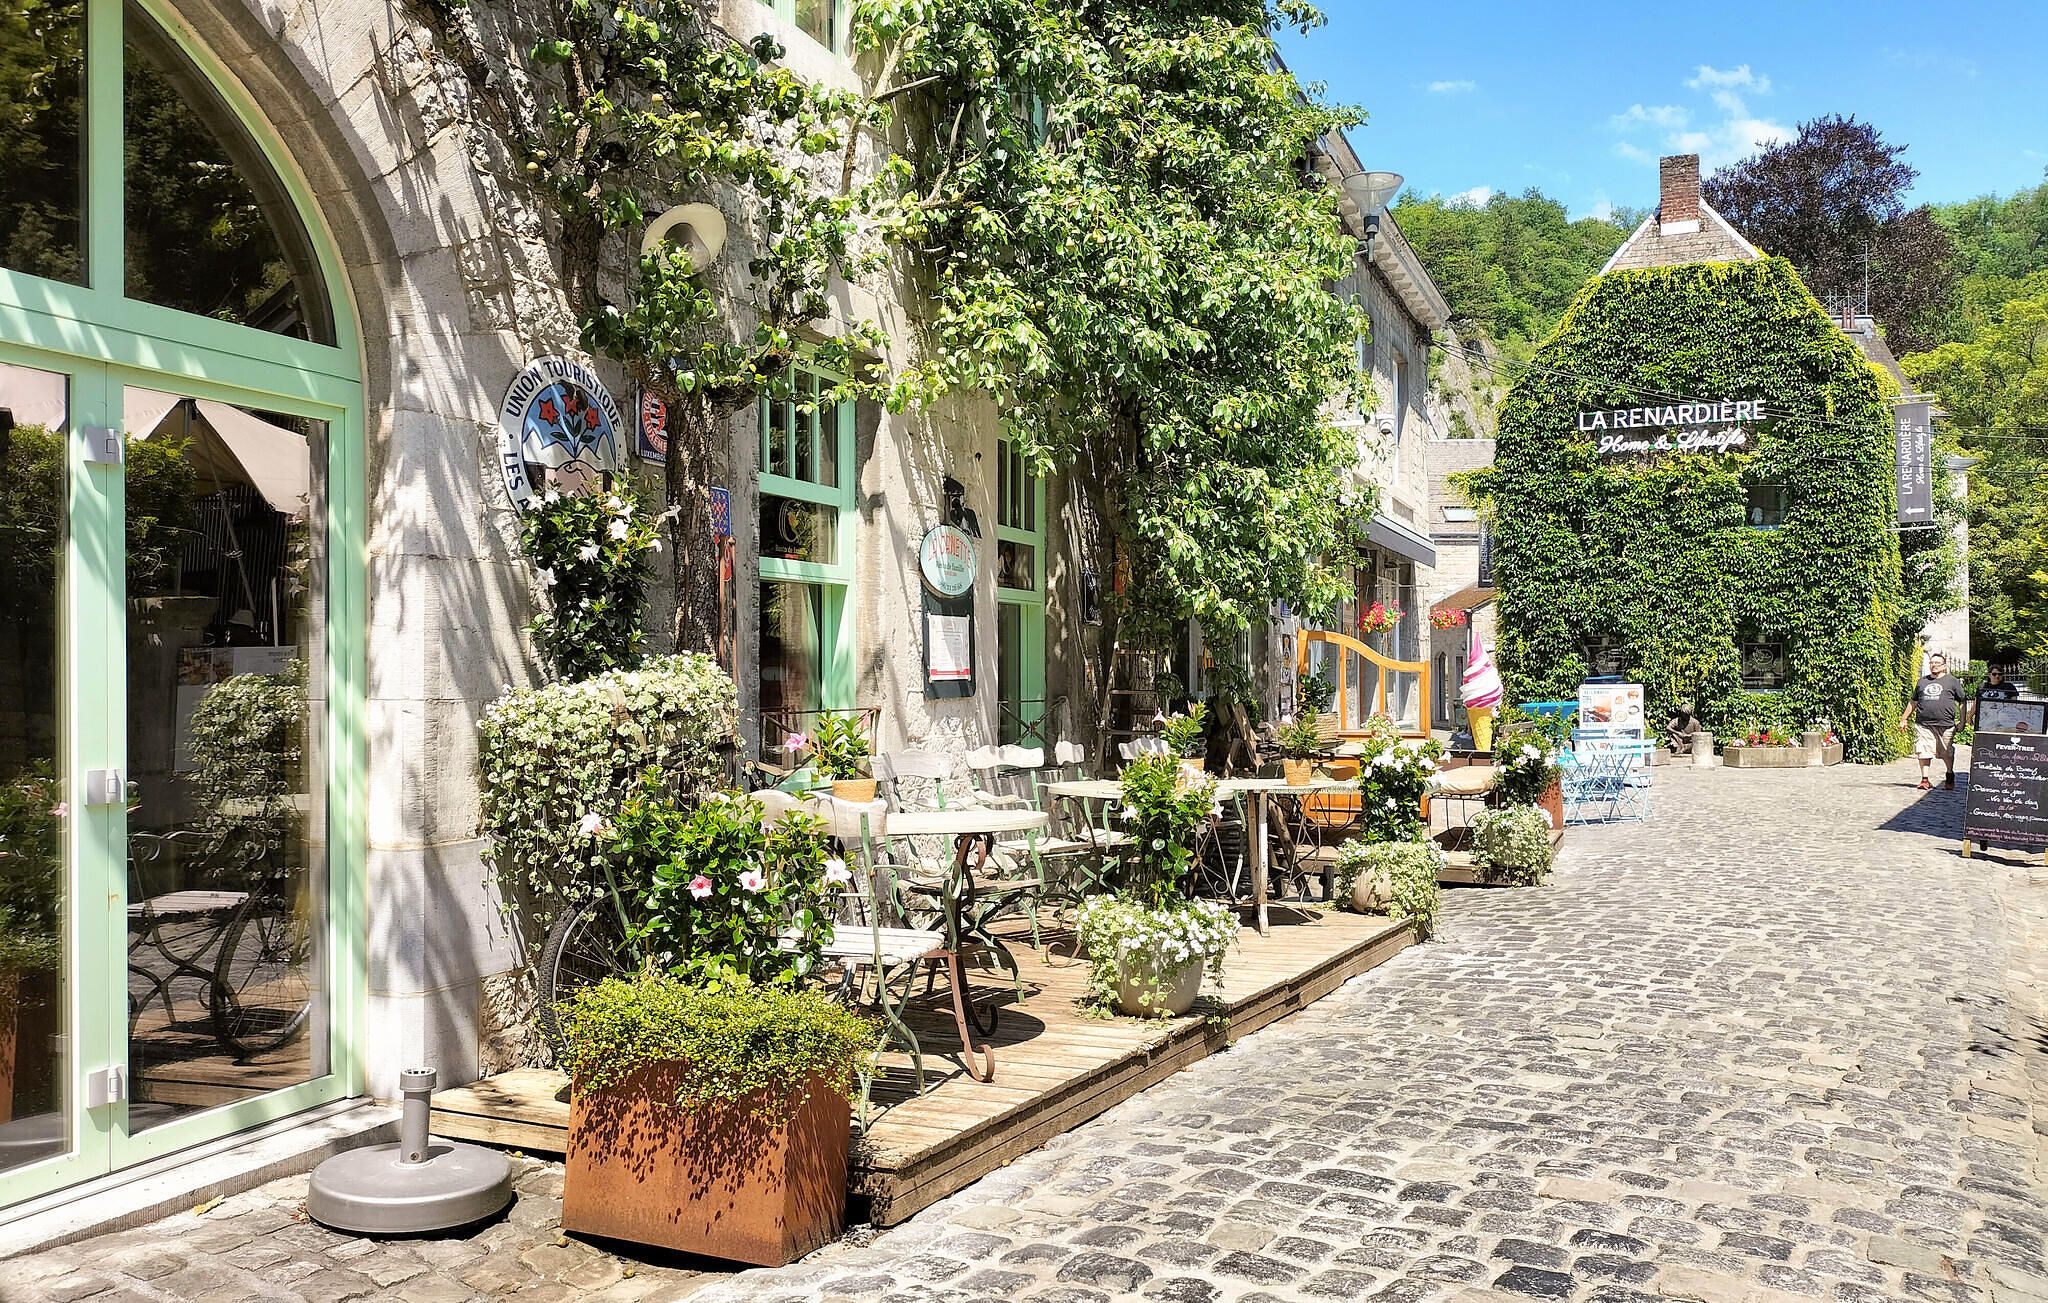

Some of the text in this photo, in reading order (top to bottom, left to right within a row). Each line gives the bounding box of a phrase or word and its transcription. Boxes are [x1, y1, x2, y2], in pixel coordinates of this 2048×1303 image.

[506, 361, 621, 432] UNION TOURISTIQUE
[1579, 397, 1768, 431] LA RENARDIÈRE
[1599, 427, 1748, 454] Home & Lifestyle
[1898, 417, 1913, 495] LA RENARDIÈRE
[503, 452, 525, 491] LES
[1995, 744, 2035, 752] FEVER-TREE
